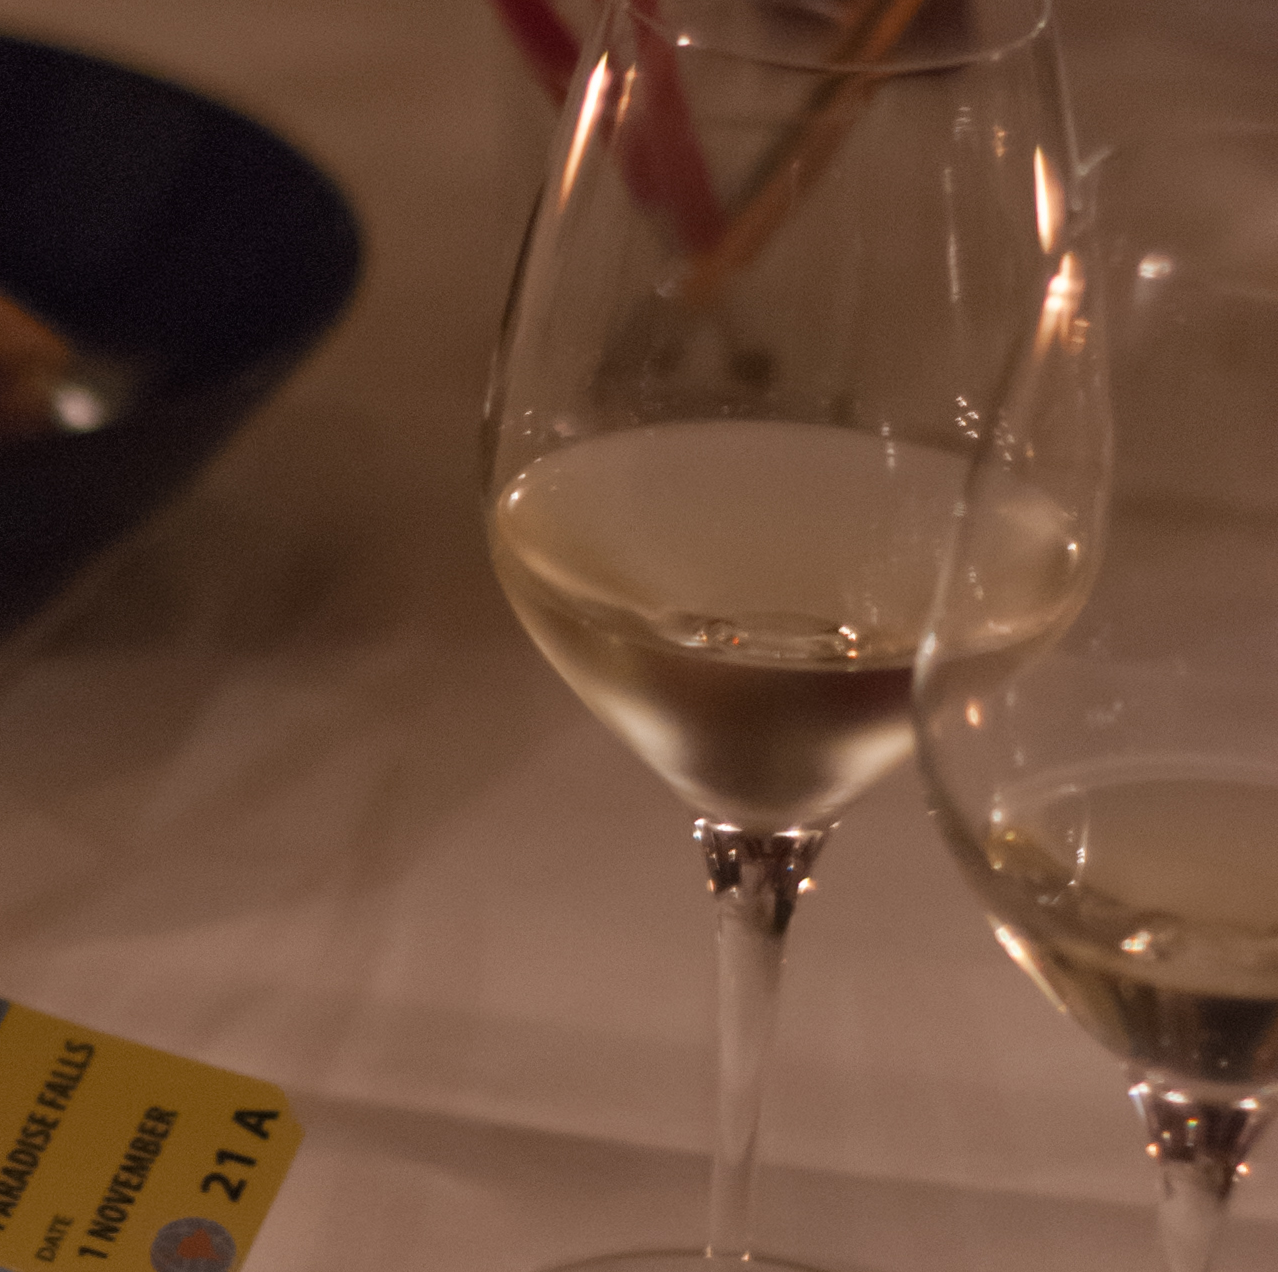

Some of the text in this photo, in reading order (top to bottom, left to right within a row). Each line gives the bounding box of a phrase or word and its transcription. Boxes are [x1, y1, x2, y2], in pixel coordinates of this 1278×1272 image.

[36, 1040, 95, 1111] FALLS
[78, 1106, 178, 1259] 1 NOVEMBER
[200, 1109, 280, 1203] 21 A
[35, 1214, 74, 1262] DATE
